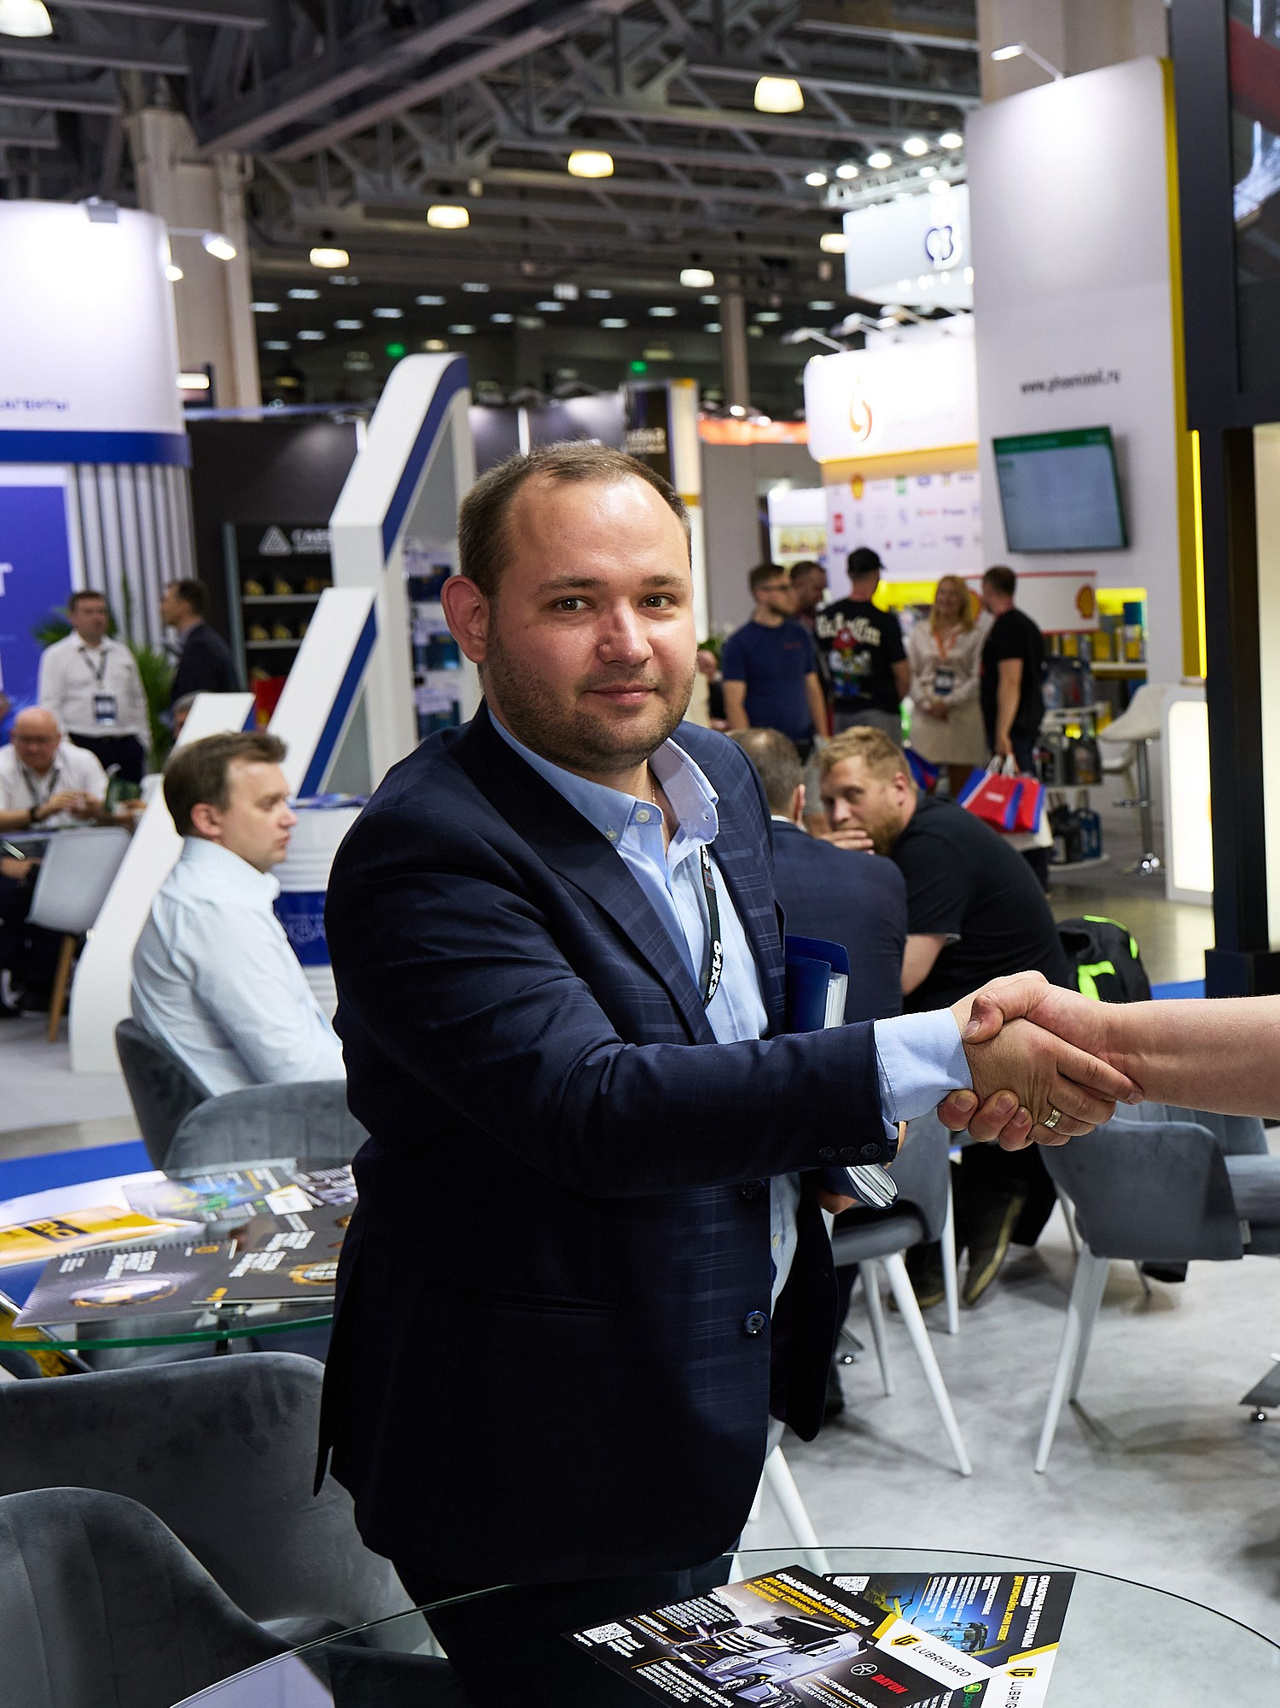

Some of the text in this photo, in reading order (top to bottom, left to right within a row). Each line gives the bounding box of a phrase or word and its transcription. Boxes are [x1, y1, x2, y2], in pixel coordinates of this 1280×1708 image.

[772, 1572, 876, 1627] СМАЗОЧНЫЕ МАТЕРИАЛЫ
[1021, 1575, 1051, 1648] СМАЗОЧНЫЕ МАТЕРИАЛЫ
[826, 1611, 861, 1629] РАБОТЫ
[912, 1645, 973, 1678] LUBRIGARD
[868, 1673, 910, 1694] DAYUN
